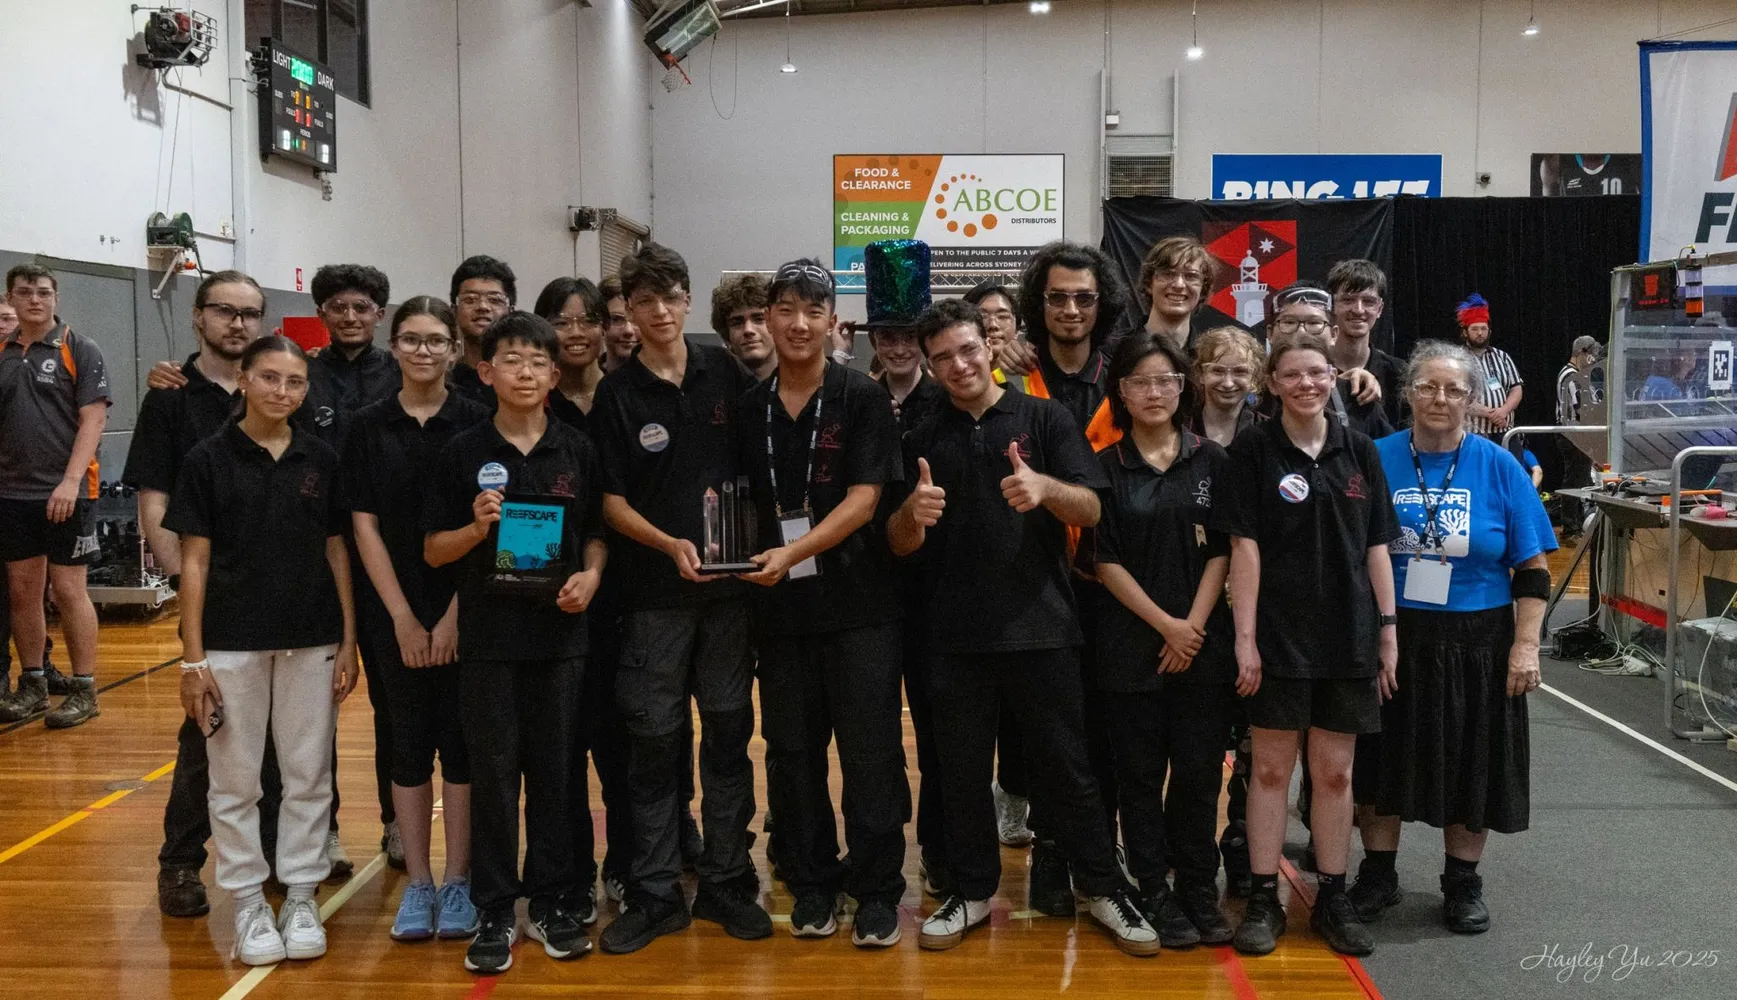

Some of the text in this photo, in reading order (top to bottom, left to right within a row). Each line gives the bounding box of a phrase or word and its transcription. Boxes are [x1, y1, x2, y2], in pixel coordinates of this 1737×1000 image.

[272, 49, 291, 70] LIGHT
[317, 71, 334, 92] DARK
[854, 168, 899, 177] FOOD &
[841, 181, 911, 190] CLEARANCE
[1601, 178, 1622, 195] 10
[953, 189, 1057, 212] ABCOE
[841, 213, 909, 222] CLEANING &
[841, 225, 910, 235] PACKAGING
[1395, 493, 1466, 506] REESCAPE
[505, 508, 558, 522] REEFSCAPE
